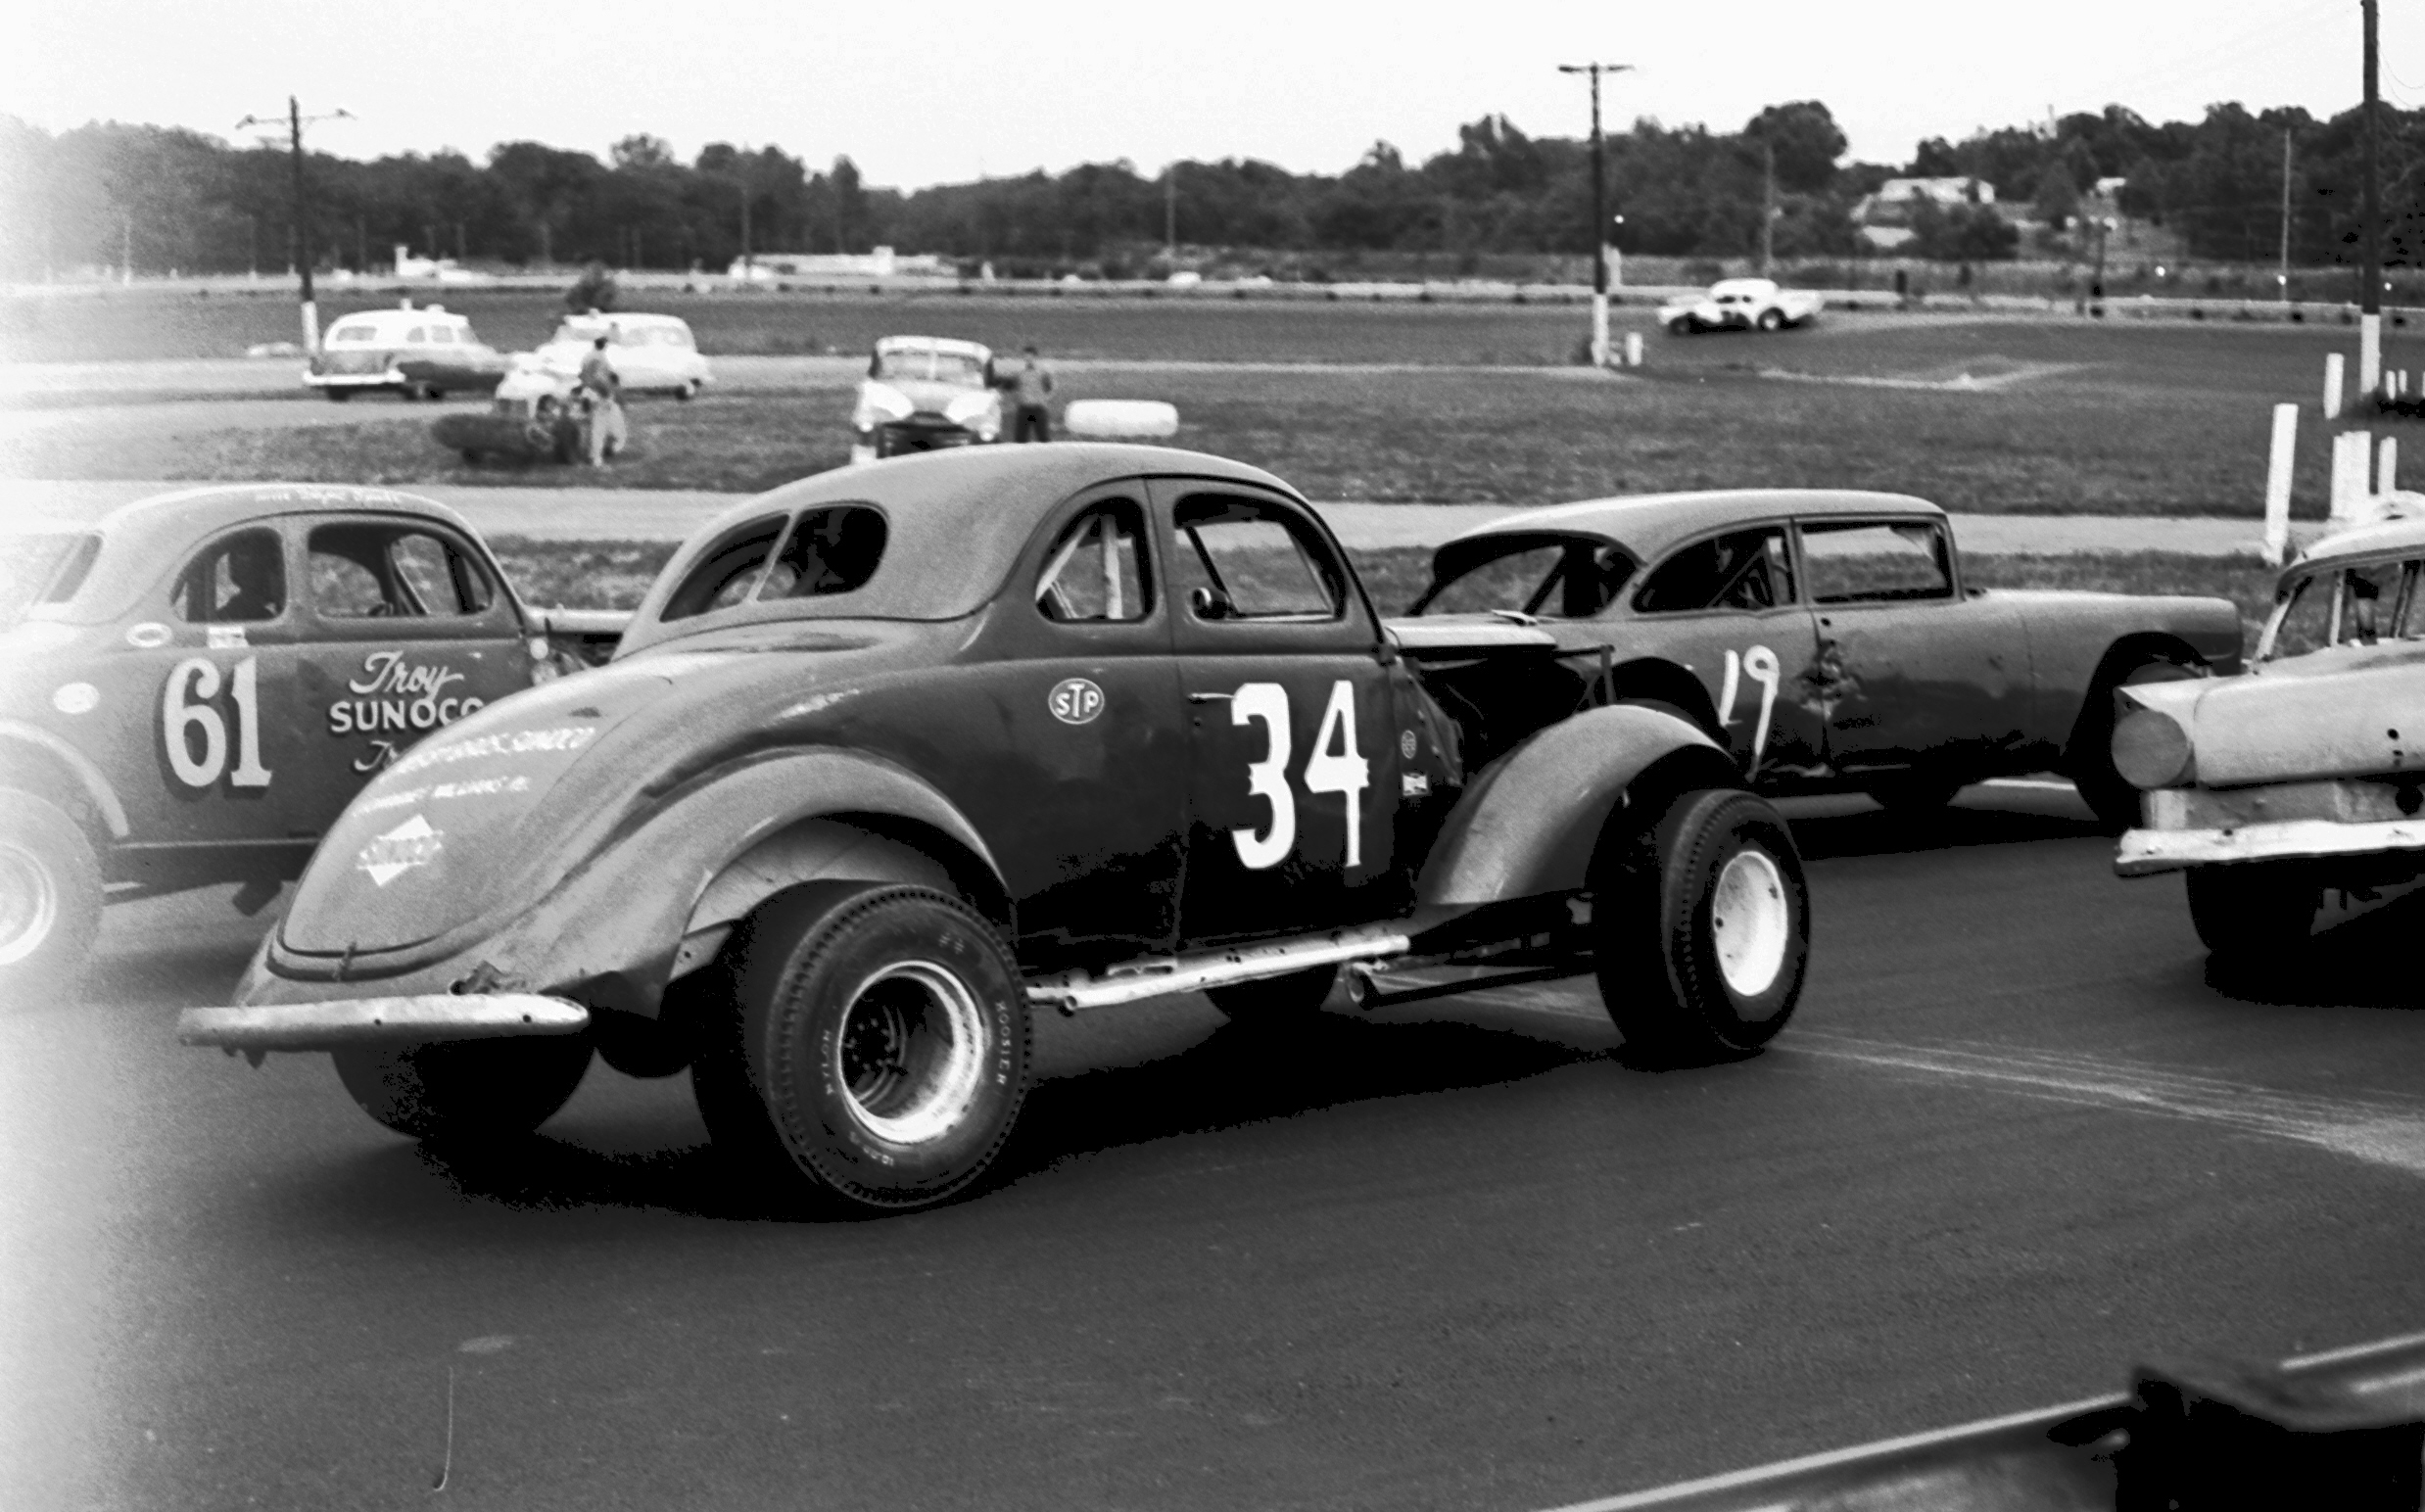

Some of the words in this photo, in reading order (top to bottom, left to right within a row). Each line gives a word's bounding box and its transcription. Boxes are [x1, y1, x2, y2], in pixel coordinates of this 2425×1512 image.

[164, 655, 273, 787] 61
[350, 650, 465, 702] Troy
[1056, 683, 1099, 718] STP
[1718, 644, 1781, 783] 19
[1230, 680, 1370, 870] 34
